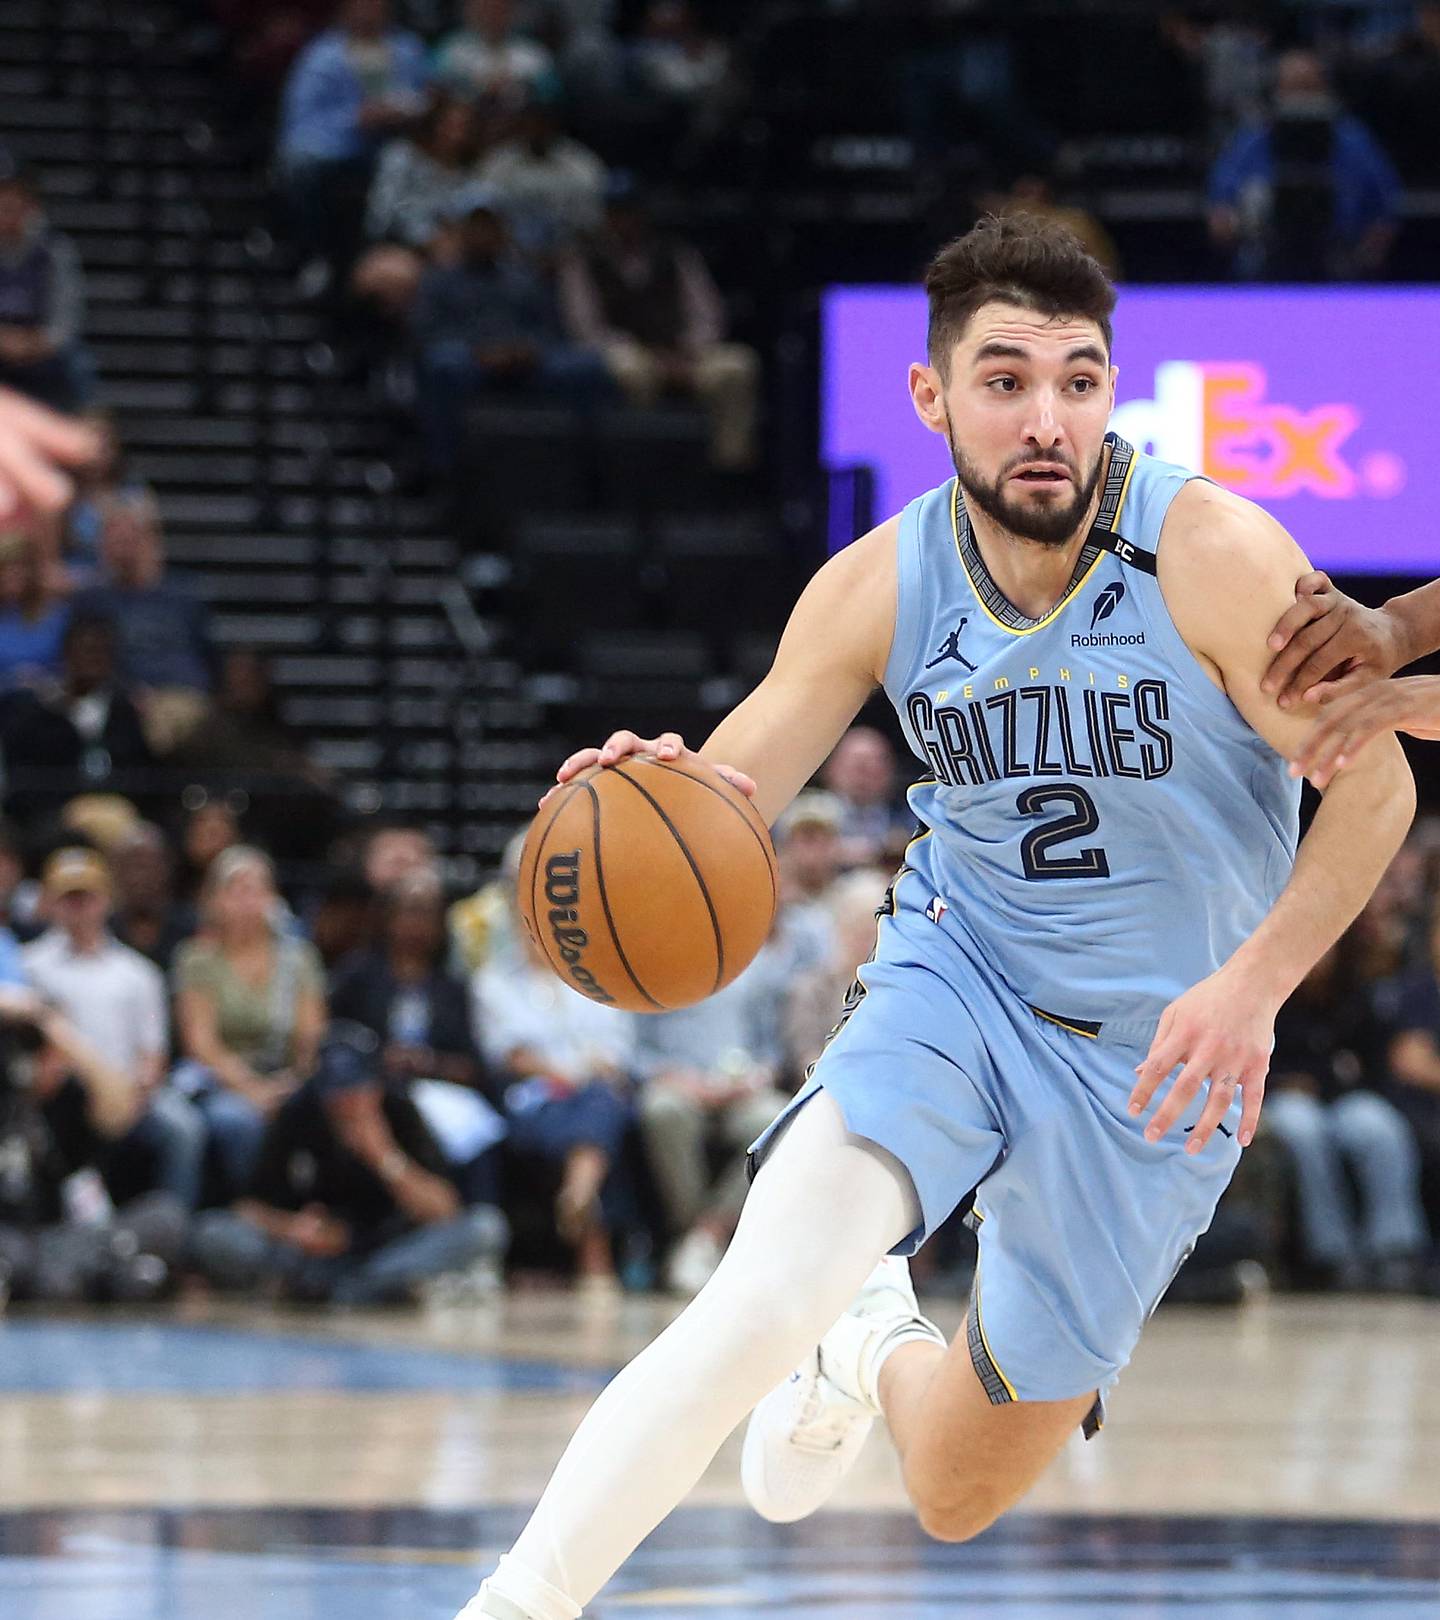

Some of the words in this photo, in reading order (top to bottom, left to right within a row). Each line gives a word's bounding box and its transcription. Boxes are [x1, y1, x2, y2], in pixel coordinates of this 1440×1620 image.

[1109, 361, 1361, 498] dEx
[935, 667, 1129, 704] MEMPHIS
[1070, 632, 1146, 648] Robinhood
[906, 678, 1173, 787] GRIZZLIES
[1016, 782, 1111, 880] 2
